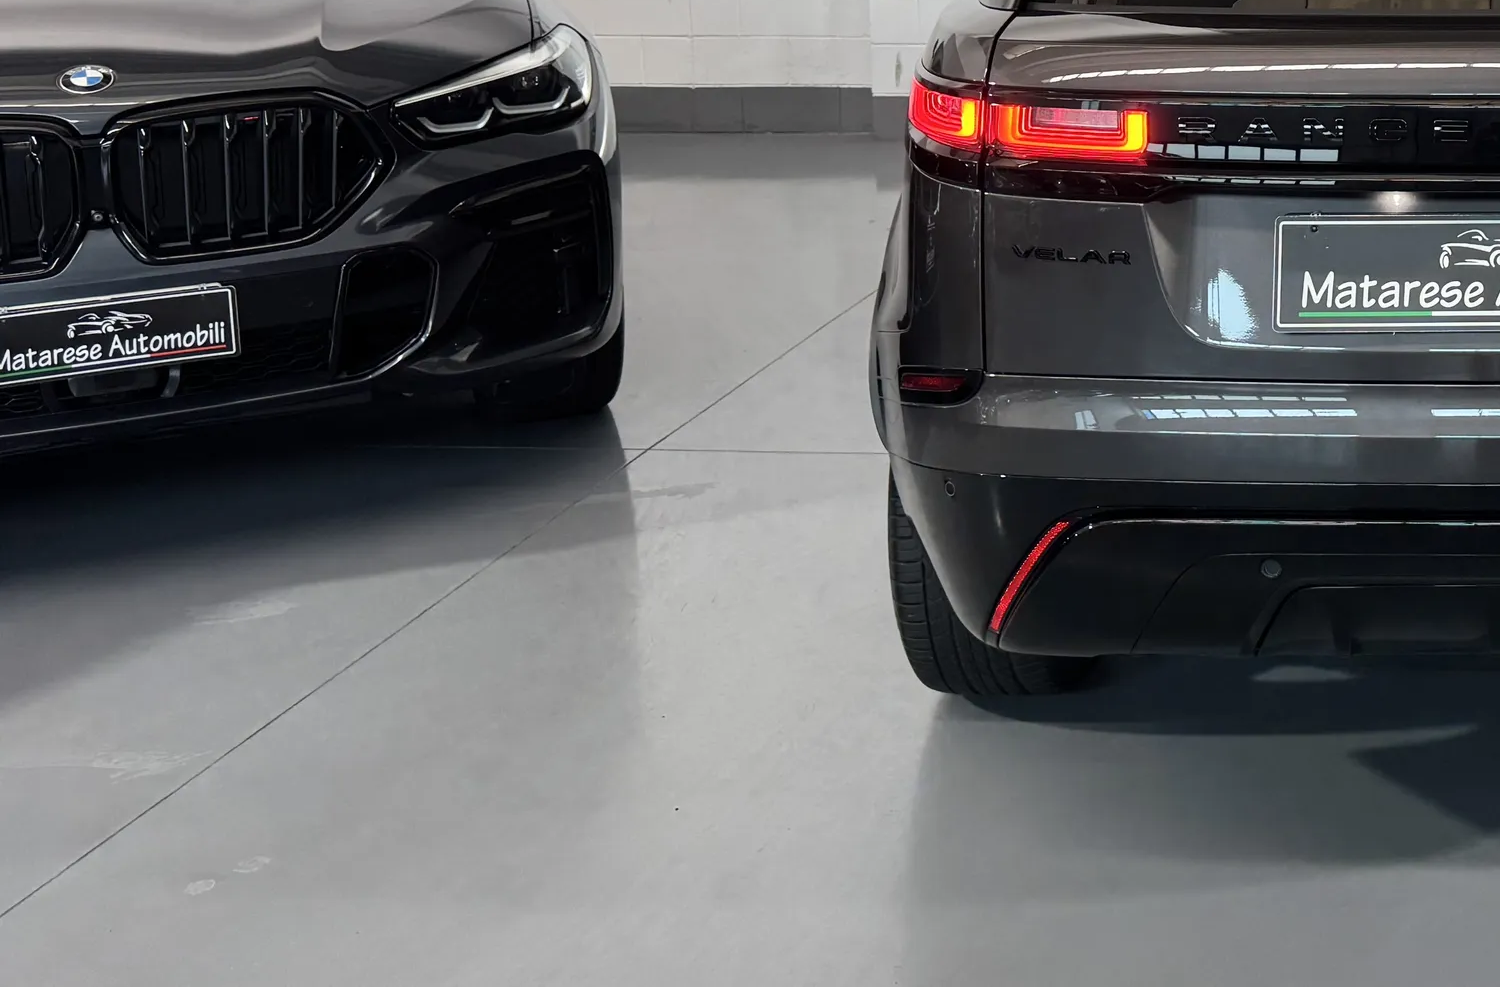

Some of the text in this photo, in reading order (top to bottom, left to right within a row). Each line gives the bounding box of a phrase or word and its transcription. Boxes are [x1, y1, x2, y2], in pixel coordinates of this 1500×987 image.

[1177, 116, 1469, 144] RANGE
[1011, 244, 1132, 265] VELAR
[1301, 271, 1484, 309] Matarese
[109, 321, 225, 357] Automobili
